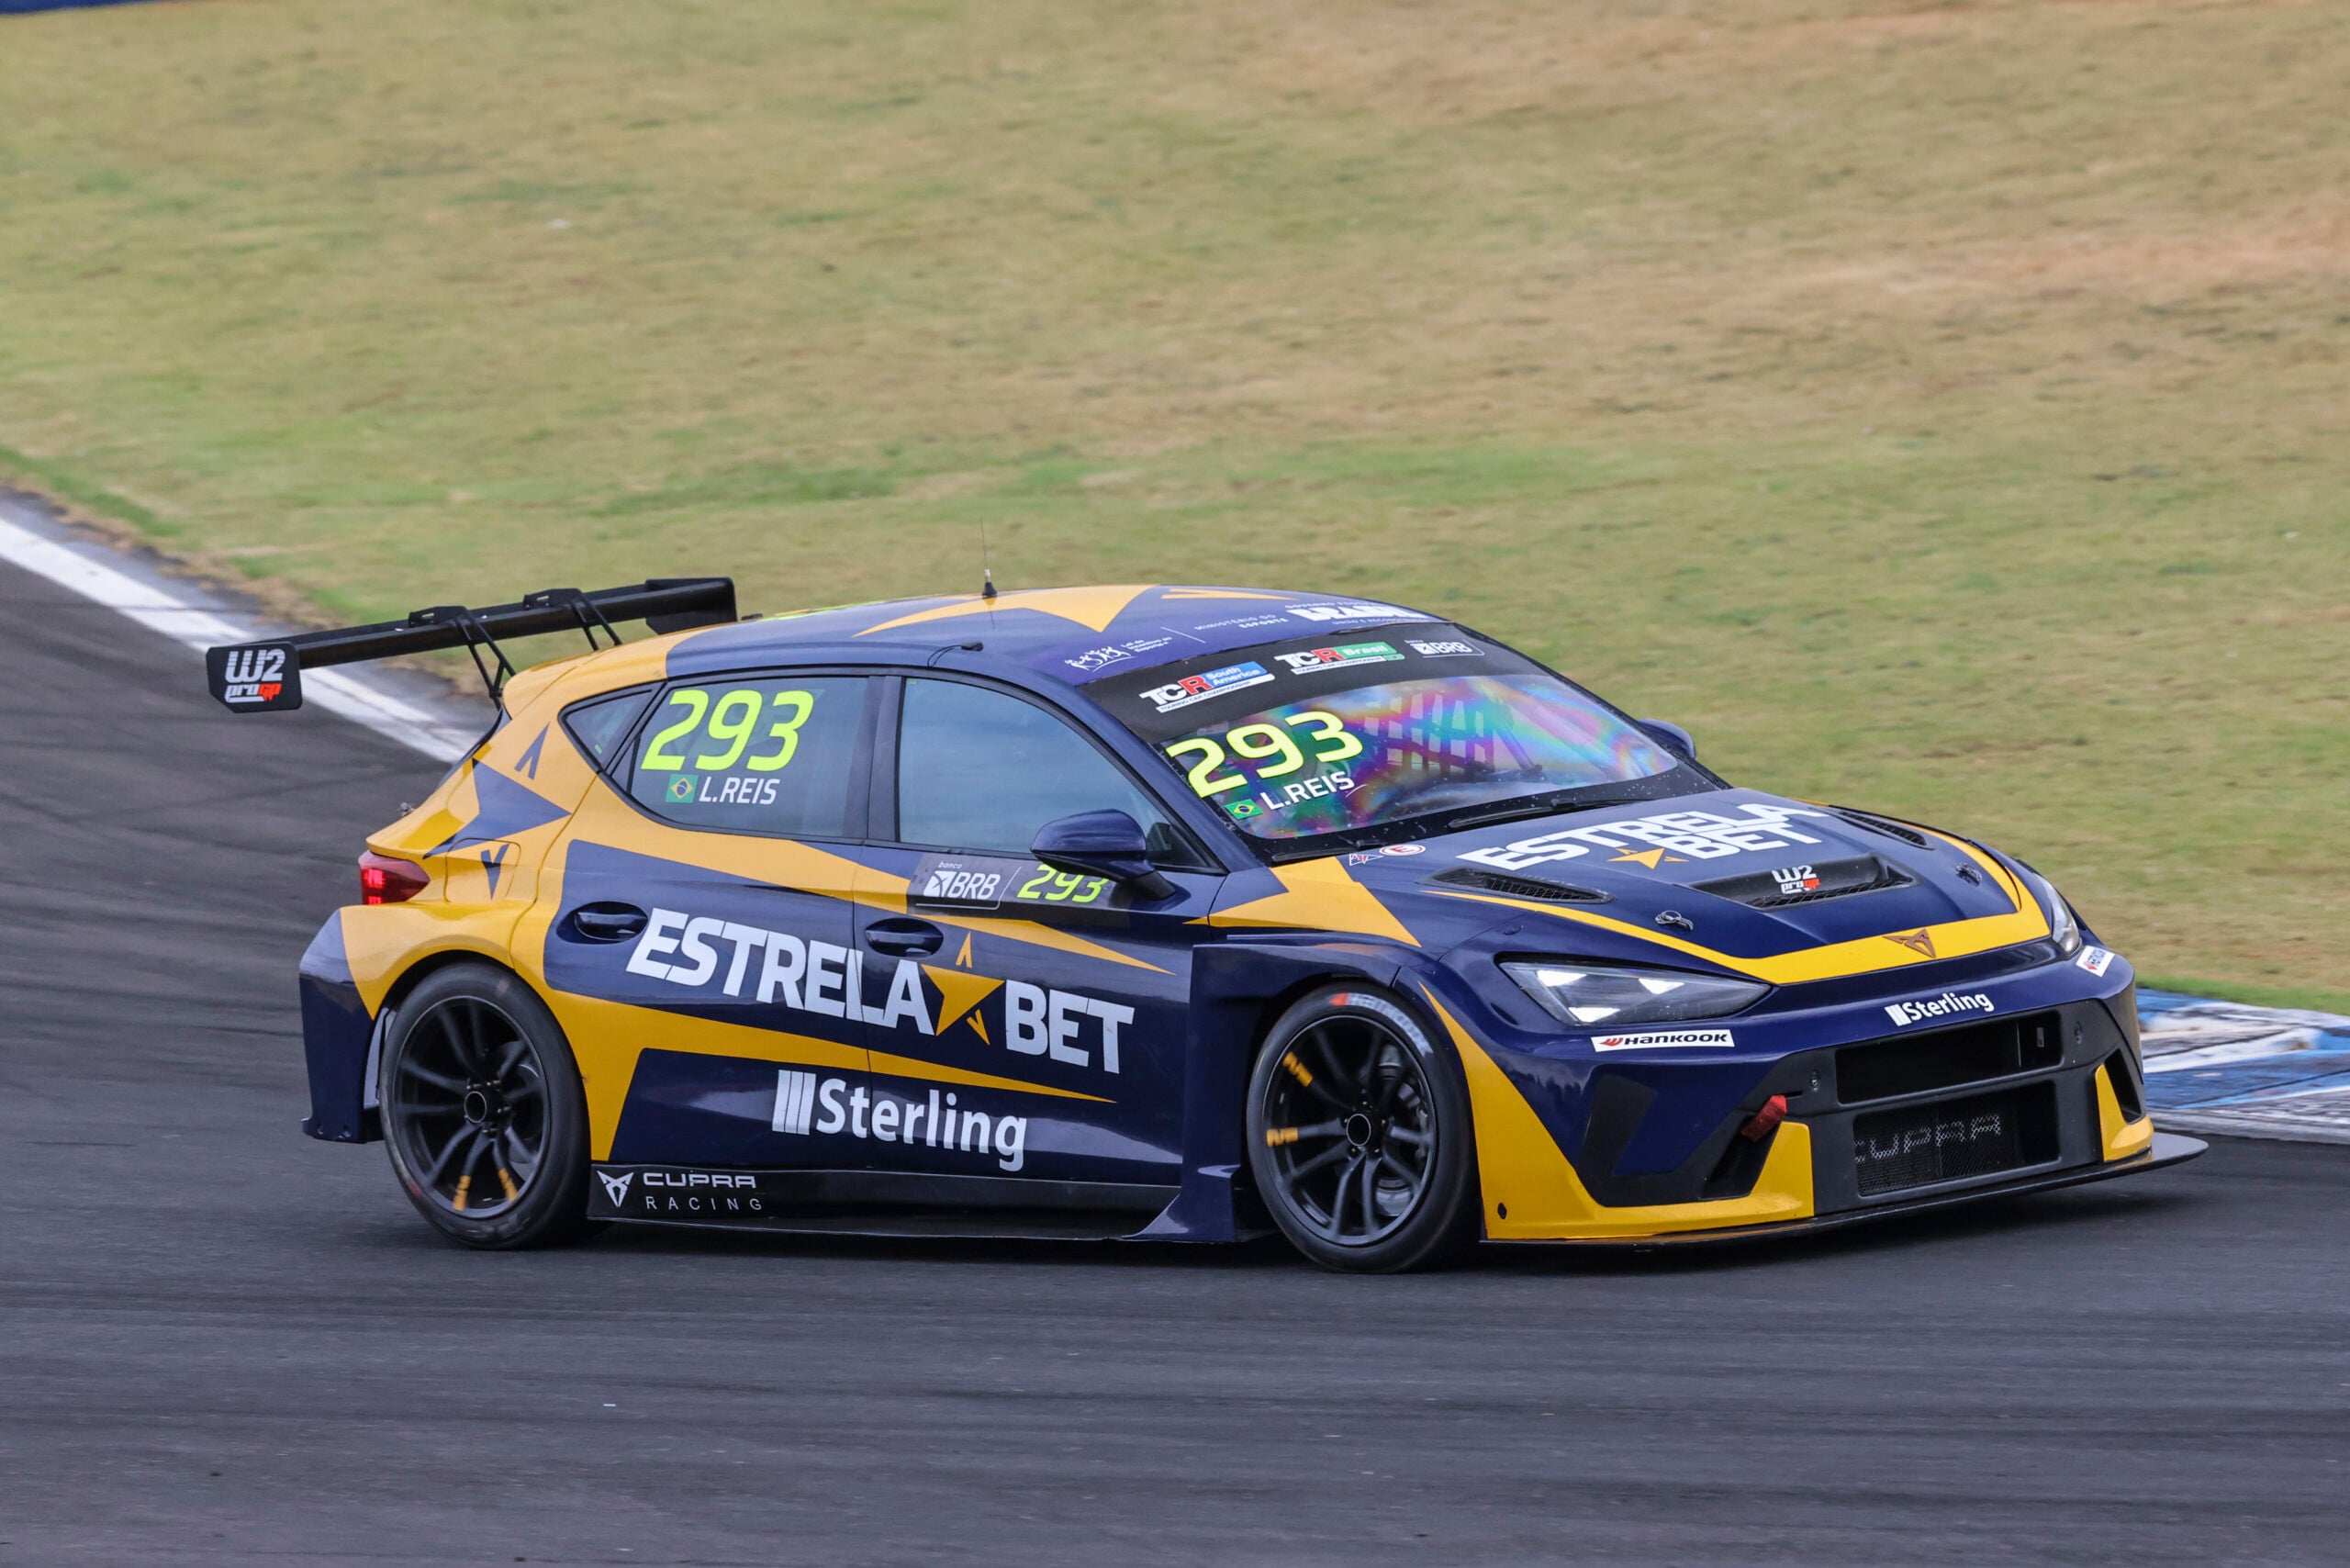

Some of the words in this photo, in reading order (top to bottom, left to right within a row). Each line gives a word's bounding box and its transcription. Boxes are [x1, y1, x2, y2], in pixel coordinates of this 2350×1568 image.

[1274, 647, 1346, 668] TCR
[1342, 644, 1388, 655] Brasil
[1428, 642, 1472, 654] BRB
[225, 649, 285, 683] W2
[1206, 666, 1241, 680] South
[1213, 669, 1261, 686] America
[1139, 675, 1214, 705] TCR
[641, 689, 814, 771] 293
[1166, 711, 1363, 798] 293
[699, 777, 780, 805] L.REIS
[1260, 771, 1355, 810] L.REIS
[1455, 802, 1830, 871] ESTRELA
[1648, 823, 1825, 859] BET
[947, 871, 1001, 900] BRB
[1017, 864, 1109, 903] 293
[1772, 865, 1818, 883] W2
[625, 907, 934, 1036] ESTRELA
[1005, 979, 1136, 1075] BET
[1902, 992, 1995, 1021] Sterling
[816, 1079, 1028, 1171] Sterling
[643, 1172, 756, 1189] CUPRA
[645, 1195, 762, 1211] RACING
